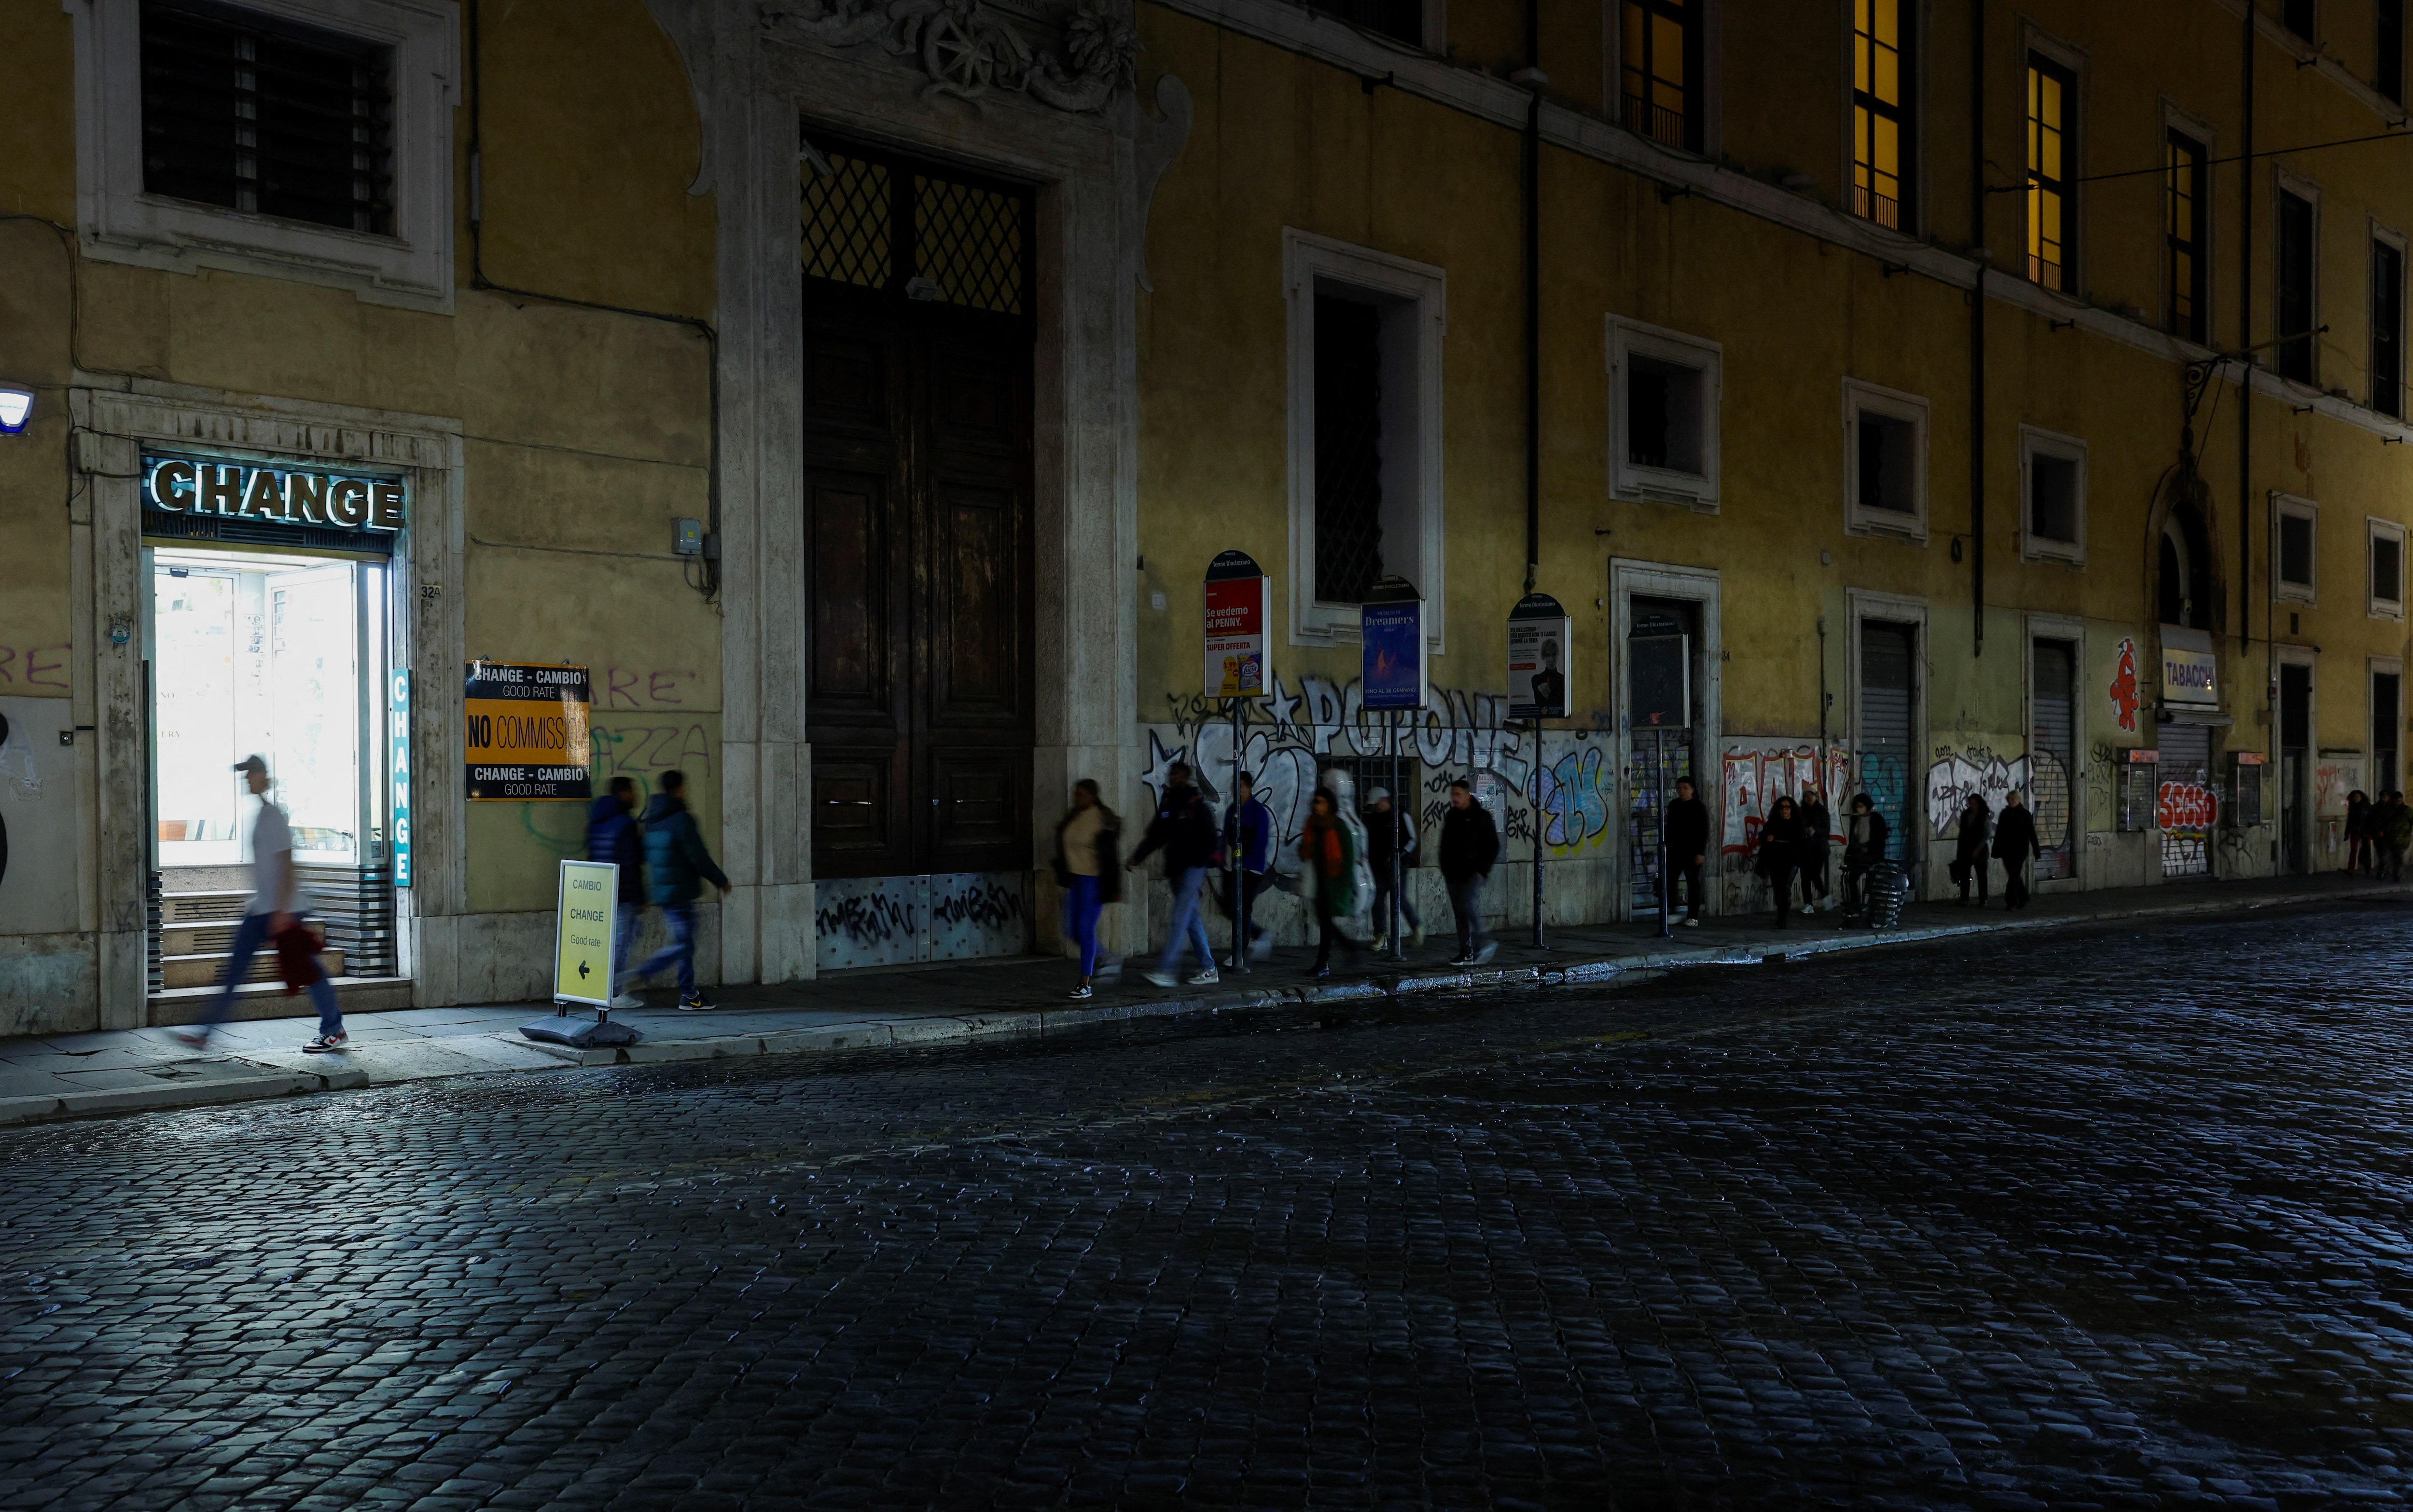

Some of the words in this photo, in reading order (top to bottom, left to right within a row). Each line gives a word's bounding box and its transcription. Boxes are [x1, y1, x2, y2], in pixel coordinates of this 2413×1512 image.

[151, 460, 404, 530] CHANGE
[421, 586, 441, 598] 32A
[1206, 608, 1215, 617] Se
[1216, 606, 1248, 617] vedemo
[1206, 619, 1214, 628] al
[1215, 617, 1242, 628] PENNY.
[1365, 616, 1414, 626] Dreamers
[1226, 642, 1250, 650] OFFERTA
[474, 668, 524, 682] CHANGE
[536, 670, 581, 685] CAMBIO
[2166, 662, 2214, 689] TABACCHI
[503, 685, 530, 697] GOOD
[533, 687, 555, 698] RATE
[468, 715, 491, 748] NO
[393, 675, 408, 880] CHANGE
[474, 767, 525, 781] CHANGE
[537, 768, 583, 781] CAMBIO
[505, 784, 531, 795] GOOD
[535, 784, 557, 795] RATE
[573, 880, 601, 891] CAMBIO
[570, 908, 604, 922] CHANGE
[570, 934, 587, 945] Good
[589, 938, 601, 947] rate
